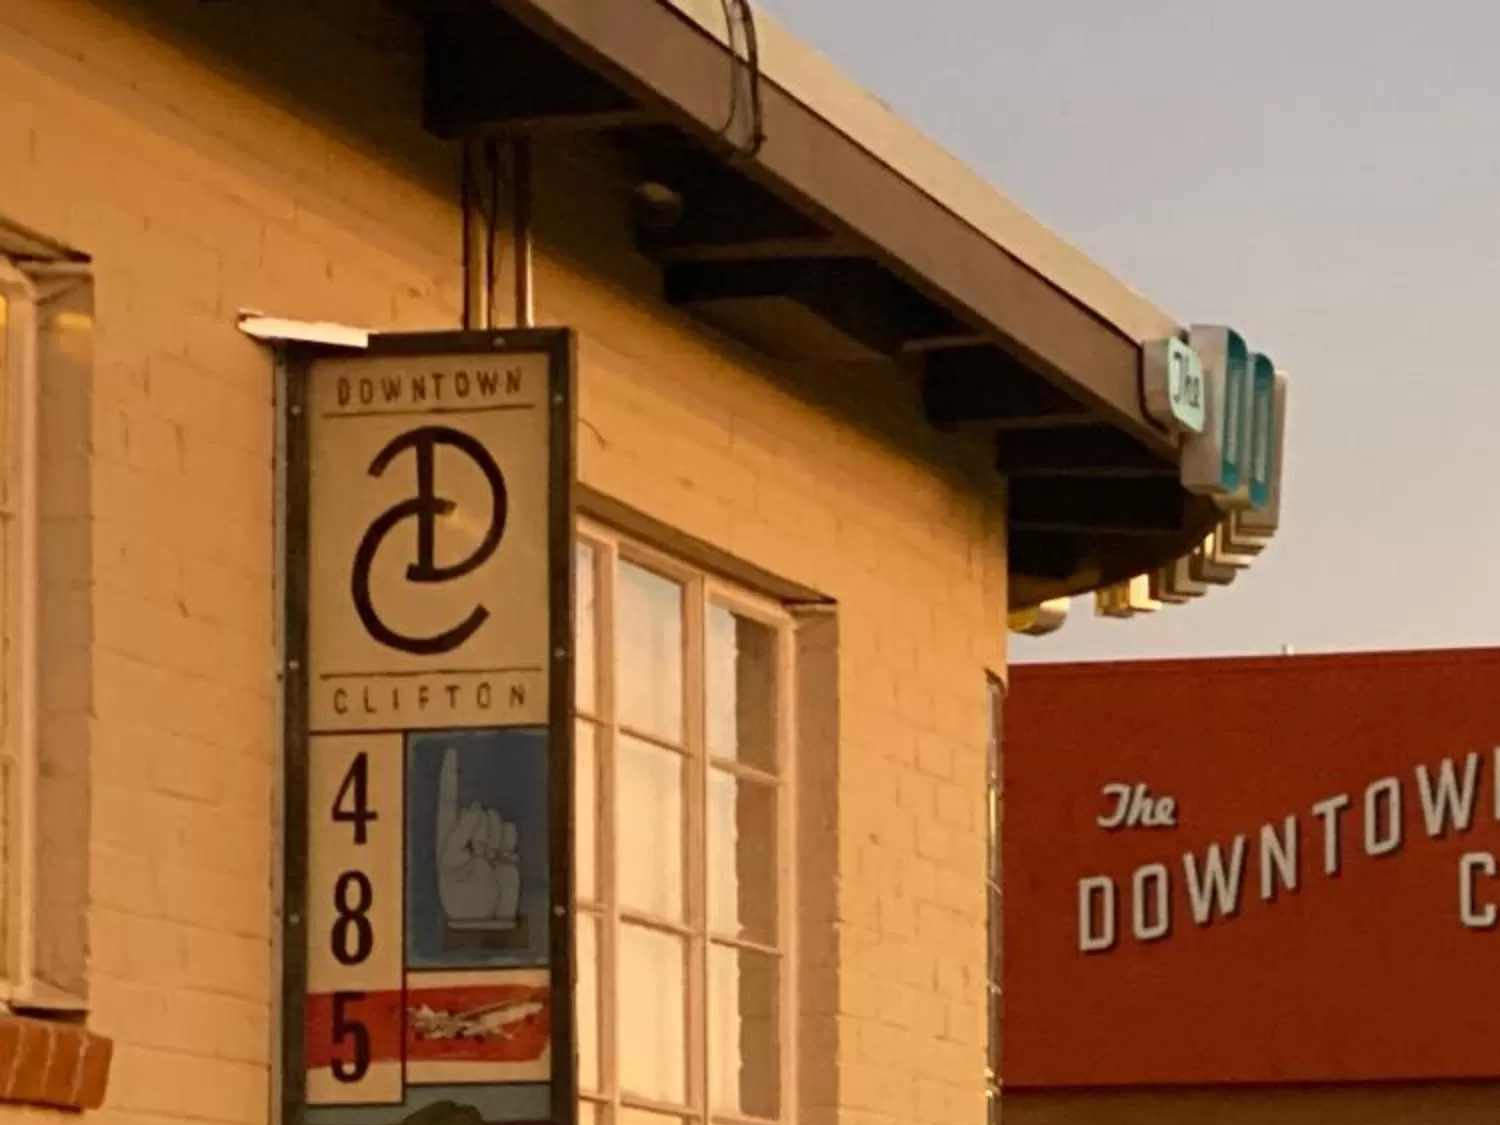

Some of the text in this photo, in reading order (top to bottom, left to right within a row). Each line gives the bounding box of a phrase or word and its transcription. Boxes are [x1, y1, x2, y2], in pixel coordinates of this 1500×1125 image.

[336, 366, 524, 407] DOWNTOWN
[332, 682, 526, 716] CLIFTON
[1096, 782, 1177, 830] The
